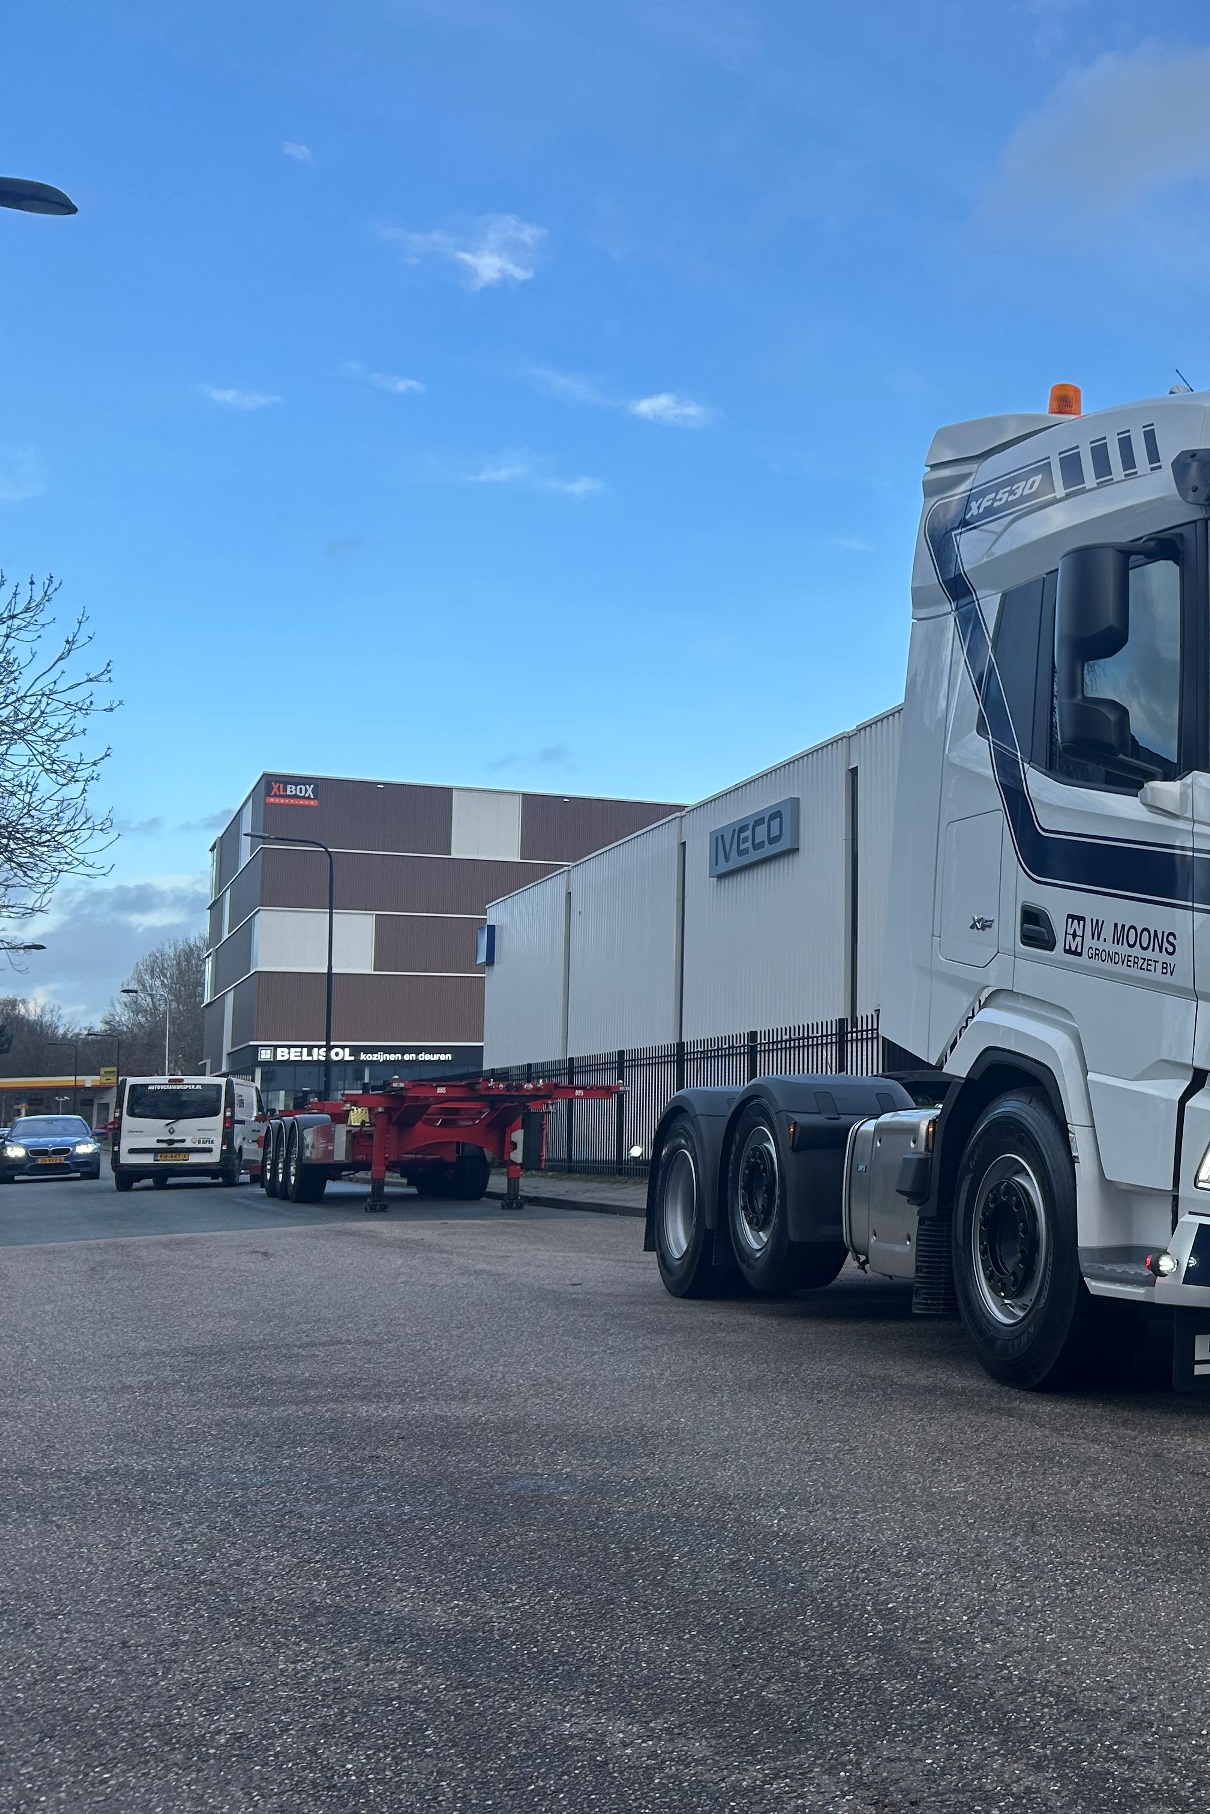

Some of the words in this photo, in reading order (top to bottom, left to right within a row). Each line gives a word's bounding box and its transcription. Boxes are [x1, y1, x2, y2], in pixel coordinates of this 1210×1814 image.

[270, 781, 315, 799] XLBOX
[714, 809, 783, 867] IVECO
[969, 914, 995, 931] XF
[1090, 917, 1107, 943] W.
[1111, 922, 1177, 956] MOONS
[1087, 946, 1160, 974] GRONDVERZET
[1161, 961, 1176, 977] BV
[276, 1047, 355, 1061] BELISOL
[360, 1051, 402, 1063] kozijnen
[403, 1053, 416, 1061] en
[418, 1052, 452, 1061] deuren
